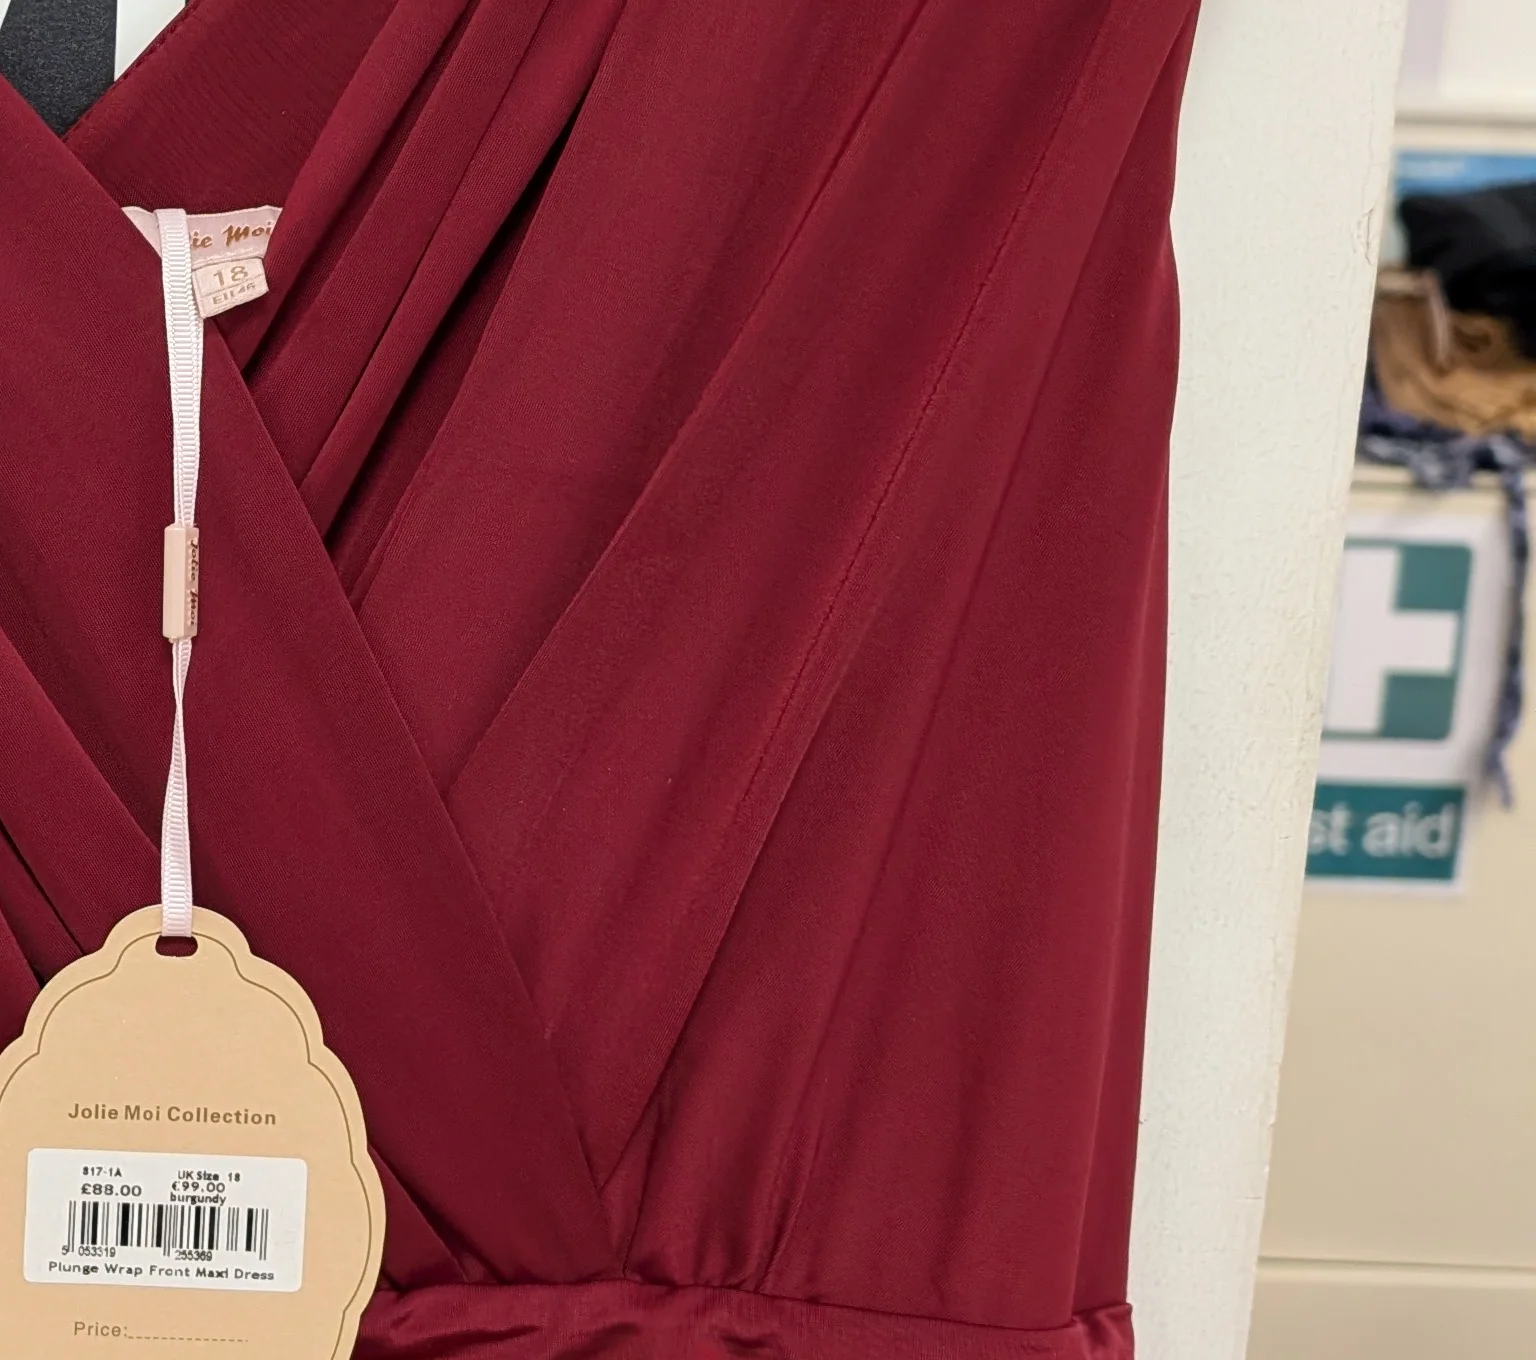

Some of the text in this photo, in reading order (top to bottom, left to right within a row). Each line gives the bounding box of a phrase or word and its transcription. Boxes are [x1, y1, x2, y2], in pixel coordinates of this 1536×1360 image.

[221, 221, 272, 247] Moi
[213, 265, 248, 287] 18
[189, 539, 198, 582] Jolie
[1362, 801, 1457, 859] aid
[68, 1103, 276, 1125] Jolie Moi Collection
[178, 1170, 241, 1182] UK Size 18
[81, 1183, 142, 1197] £88.00
[172, 1181, 226, 1193] €99.00
[170, 1192, 226, 1206] burgundy
[48, 1261, 275, 1280] Plunge Wrap Front Maxi Dress
[74, 1321, 128, 1337] Price:
